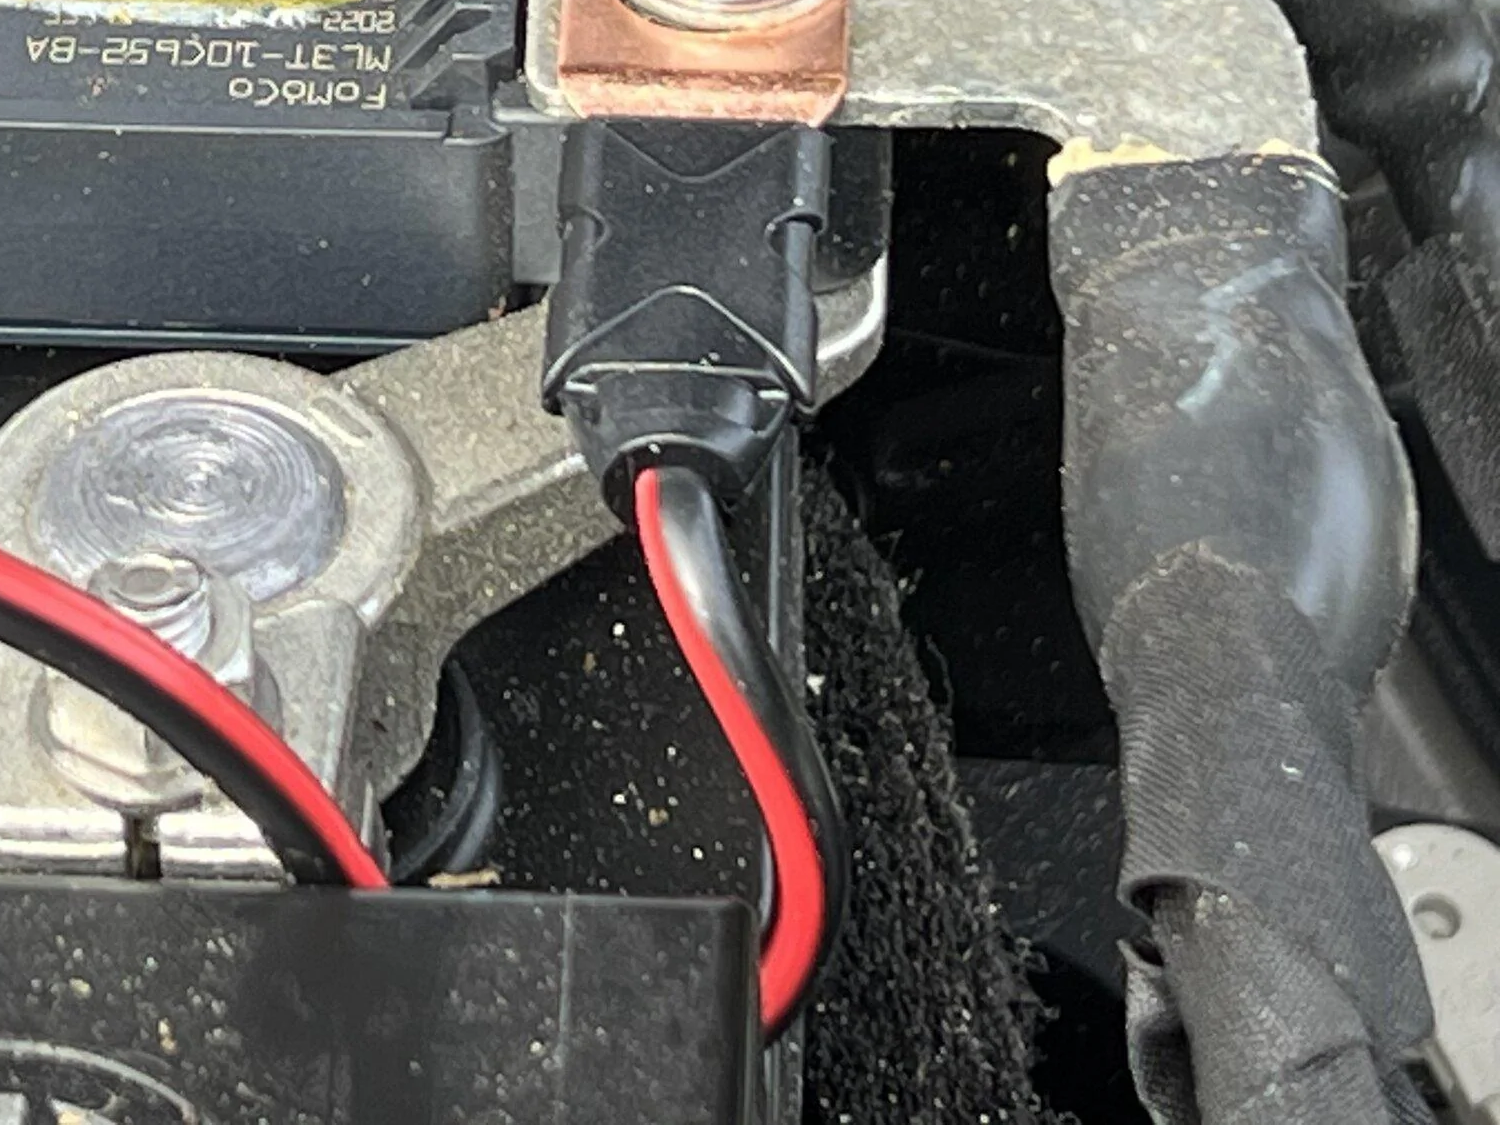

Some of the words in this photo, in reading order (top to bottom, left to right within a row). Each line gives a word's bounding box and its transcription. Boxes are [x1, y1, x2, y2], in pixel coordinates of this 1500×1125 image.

[323, 8, 397, 34] 2022
[26, 33, 392, 73] ML3T-10C652-BA
[227, 77, 387, 111] FoMoCo
